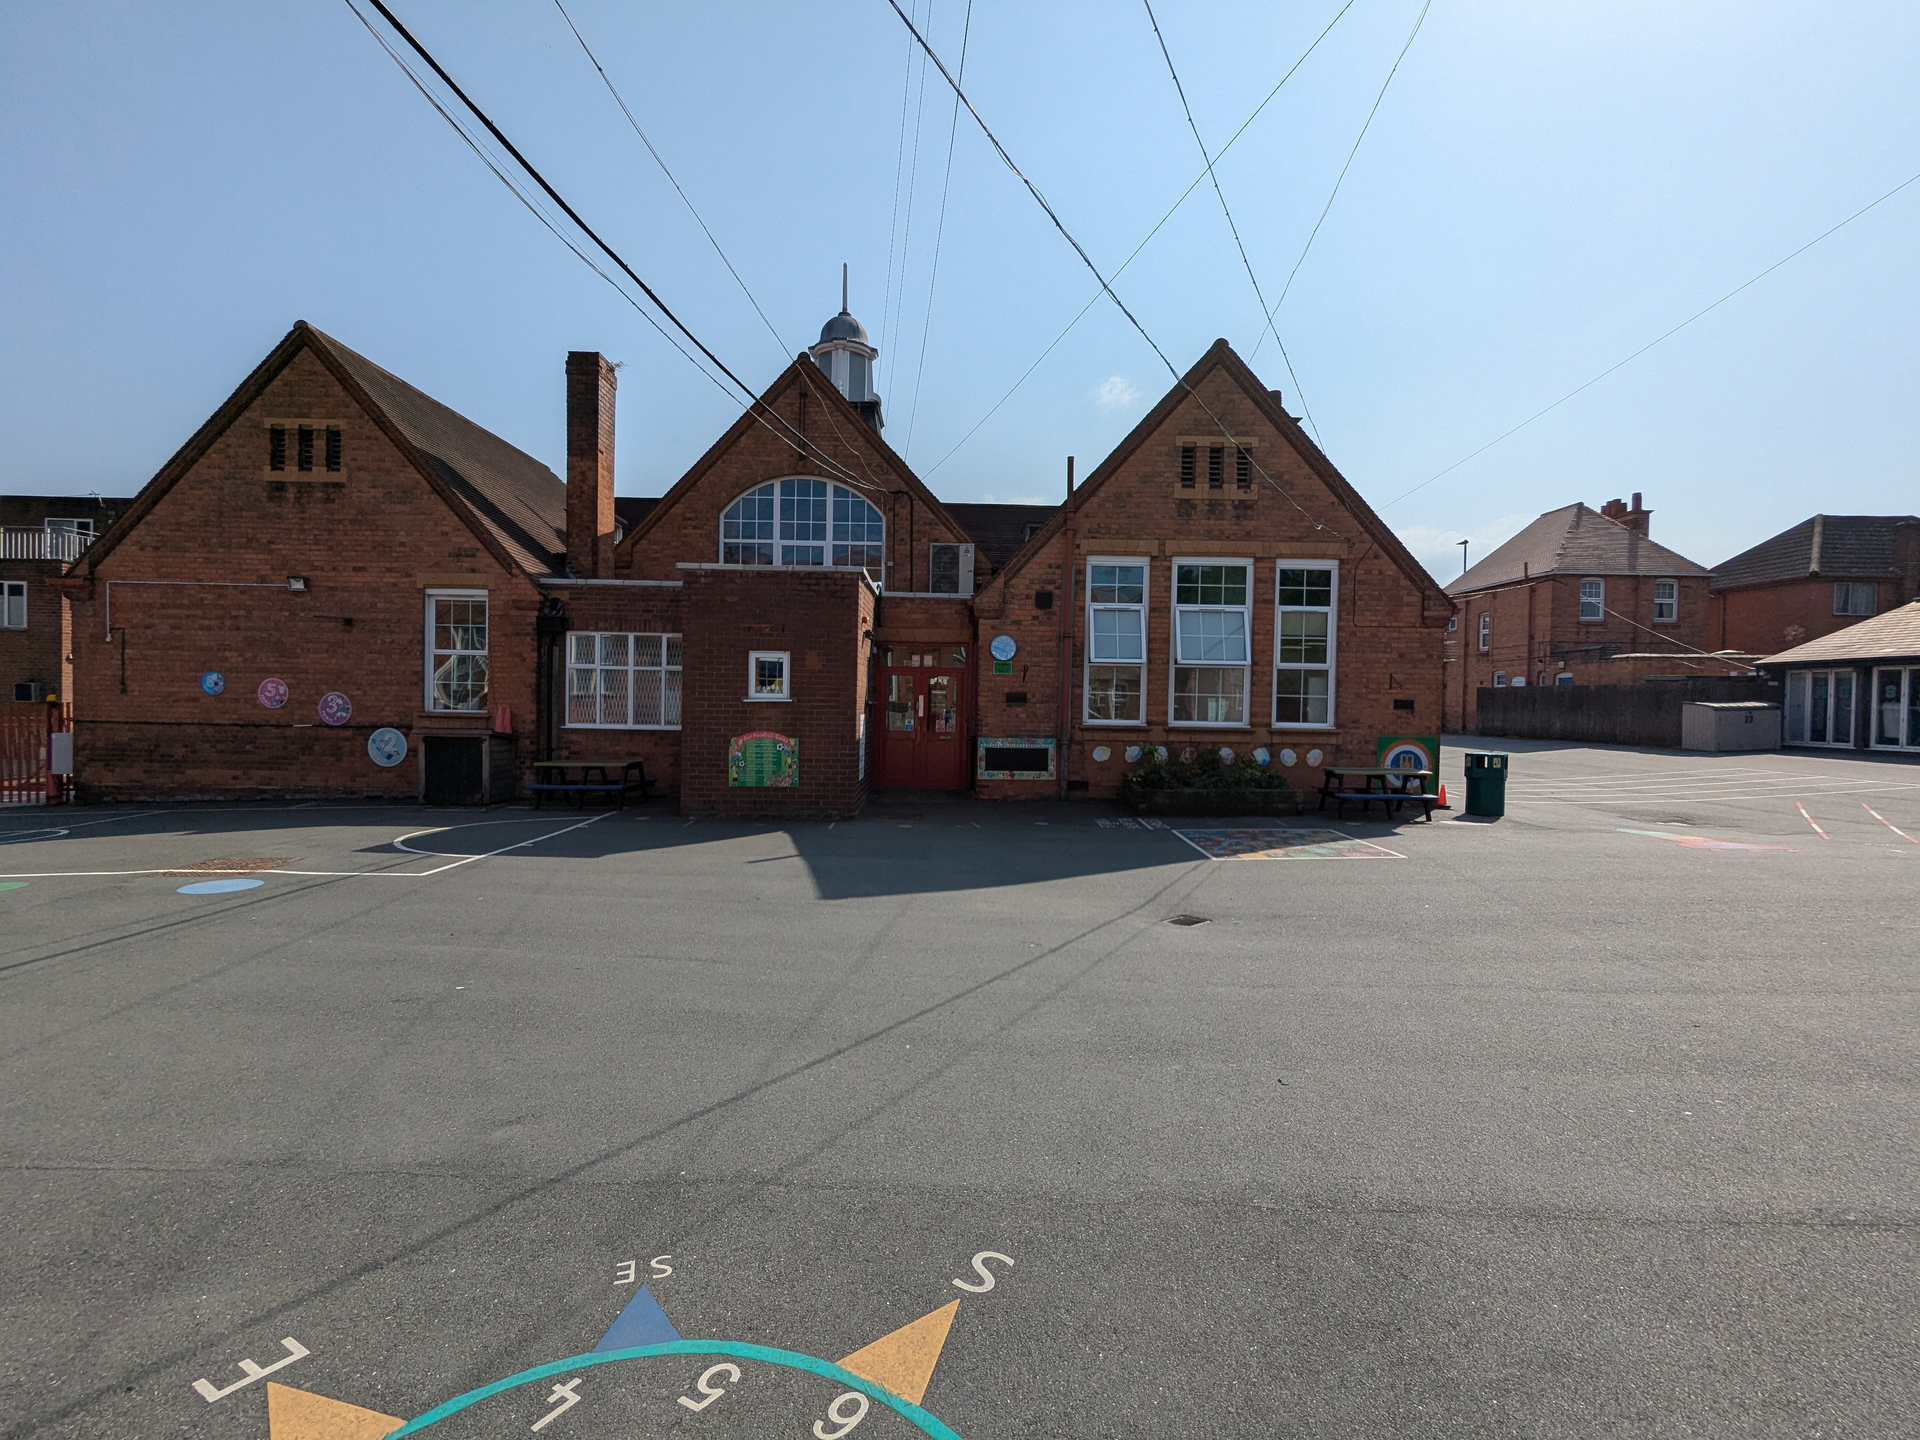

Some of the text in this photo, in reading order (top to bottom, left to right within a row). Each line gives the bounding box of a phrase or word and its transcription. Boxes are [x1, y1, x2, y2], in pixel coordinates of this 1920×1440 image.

[265, 682, 276, 697] 5
[326, 695, 338, 713] 3
[384, 732, 398, 751] 2
[613, 1255, 673, 1285] SE
[952, 1251, 1015, 1293] S
[192, 1336, 311, 1403] E
[676, 1362, 741, 1412] 5
[530, 1377, 582, 1432] 4
